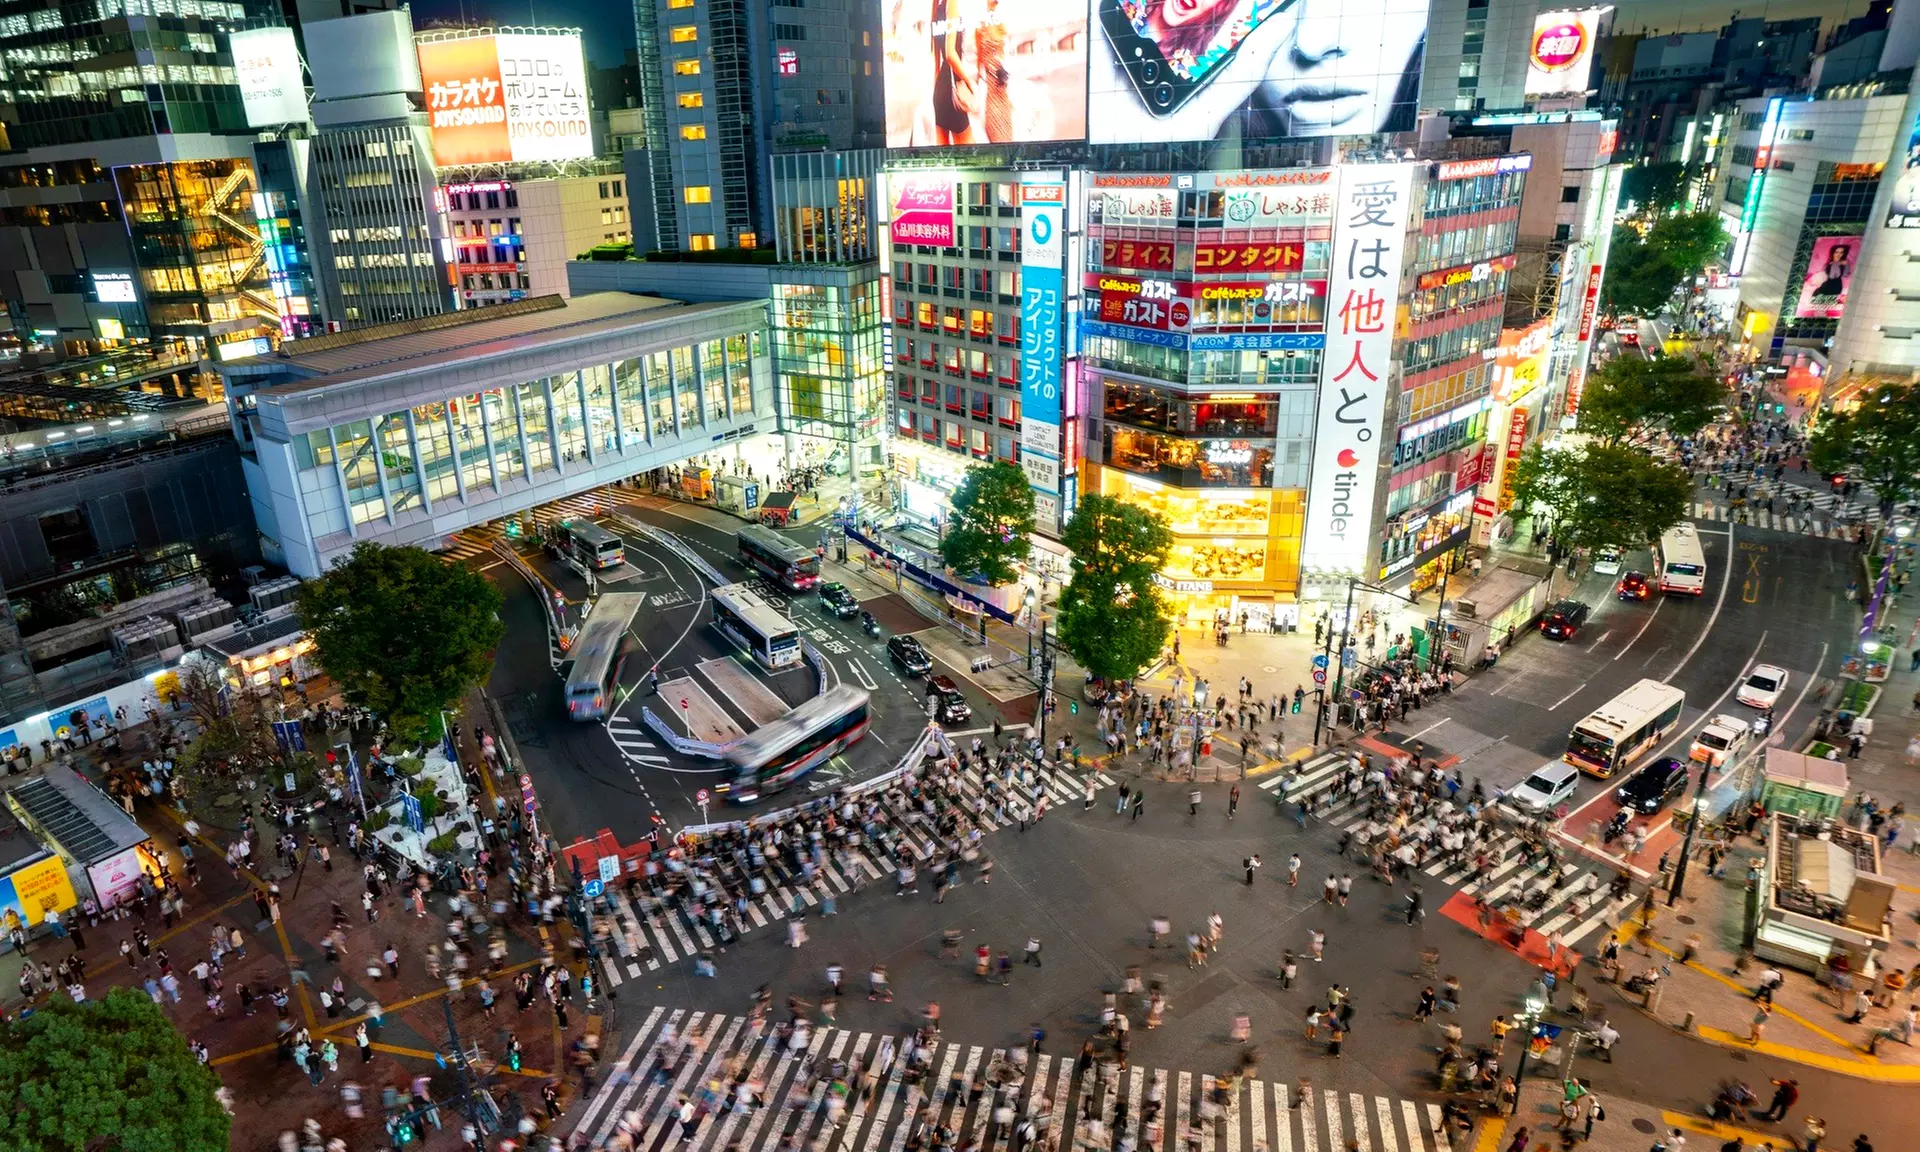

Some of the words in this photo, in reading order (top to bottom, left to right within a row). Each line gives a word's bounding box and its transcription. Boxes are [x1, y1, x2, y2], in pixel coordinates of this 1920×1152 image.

[503, 59, 563, 76] ココロの
[429, 77, 499, 109] カラオケ
[507, 80, 583, 99] ボリューム、
[433, 105, 505, 129] JOYSOUND
[509, 102, 585, 118] あげていこう。
[511, 120, 587, 138] JOYSOUND
[1093, 174, 1172, 187] しゃぶしゃぶバイキング
[1215, 171, 1332, 187] しゃぶしゃぶバイキング
[1089, 199, 1102, 213] 9F
[1128, 197, 1173, 217] しゃぶ葉
[1262, 193, 1331, 216] しゃぶ葉
[899, 223, 951, 240] 品川美容外科
[1196, 245, 1300, 266] コンタクト
[1140, 279, 1177, 300] ガスト
[1202, 287, 1263, 300] Caféレストラン
[1264, 282, 1315, 301] ガスト
[1086, 298, 1102, 312] 7F
[1123, 299, 1166, 325] ガスト
[1332, 179, 1399, 443] 愛は他人と。
[1026, 287, 1042, 397] アイシティ
[1044, 289, 1056, 400] コンタクトの
[1109, 326, 1169, 344] 英会話イーオン
[1232, 335, 1322, 349] 英会話イーオン
[1394, 436, 1424, 467] AGA
[1329, 471, 1358, 541] tinder
